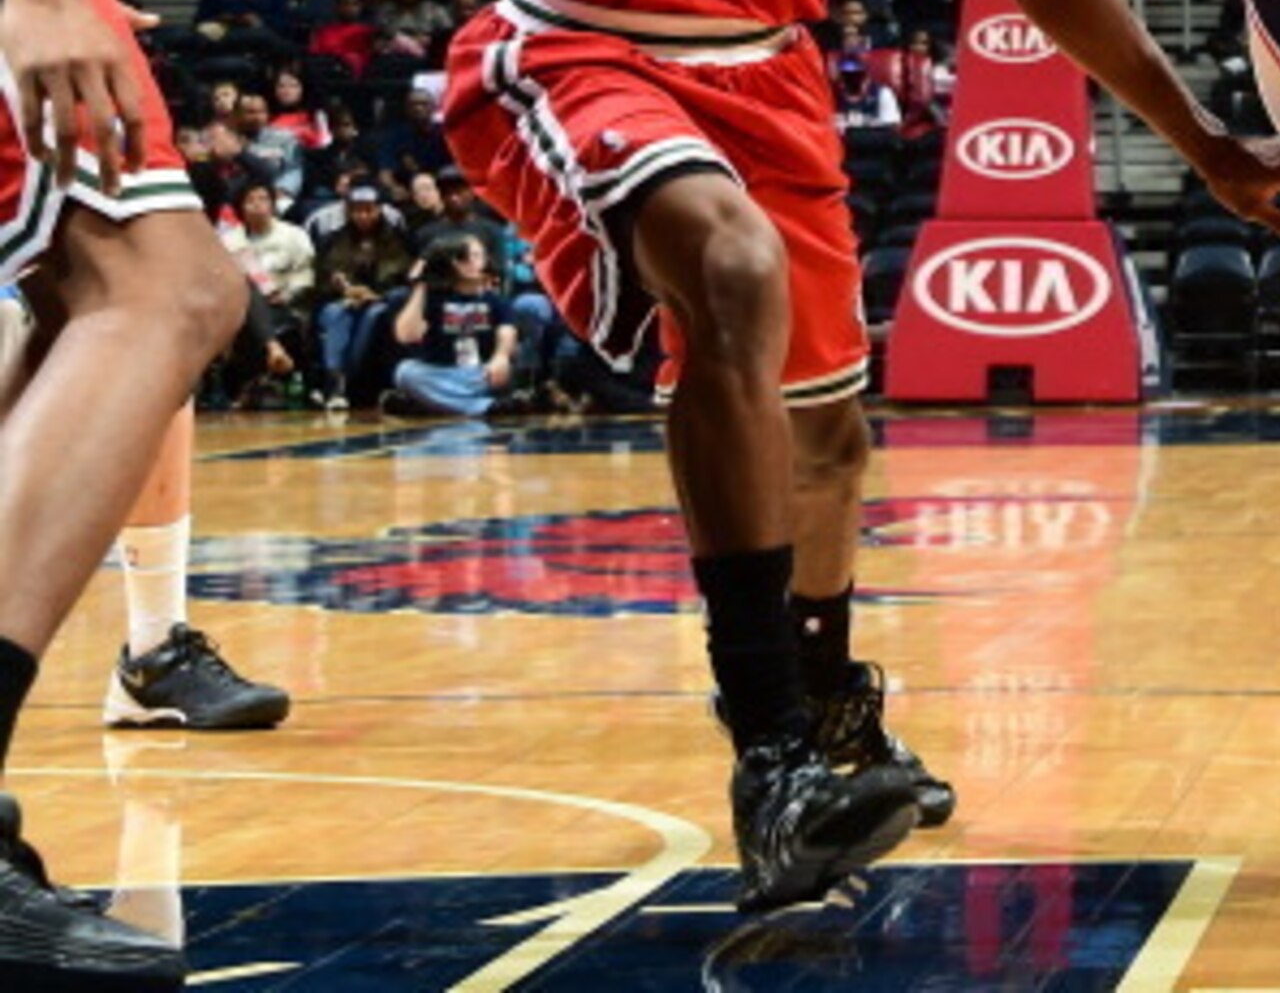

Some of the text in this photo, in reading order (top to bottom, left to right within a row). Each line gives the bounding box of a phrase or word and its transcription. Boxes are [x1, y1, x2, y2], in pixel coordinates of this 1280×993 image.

[982, 25, 1045, 50] KIA
[977, 132, 1054, 166] KIA
[951, 260, 1077, 313] KIA
